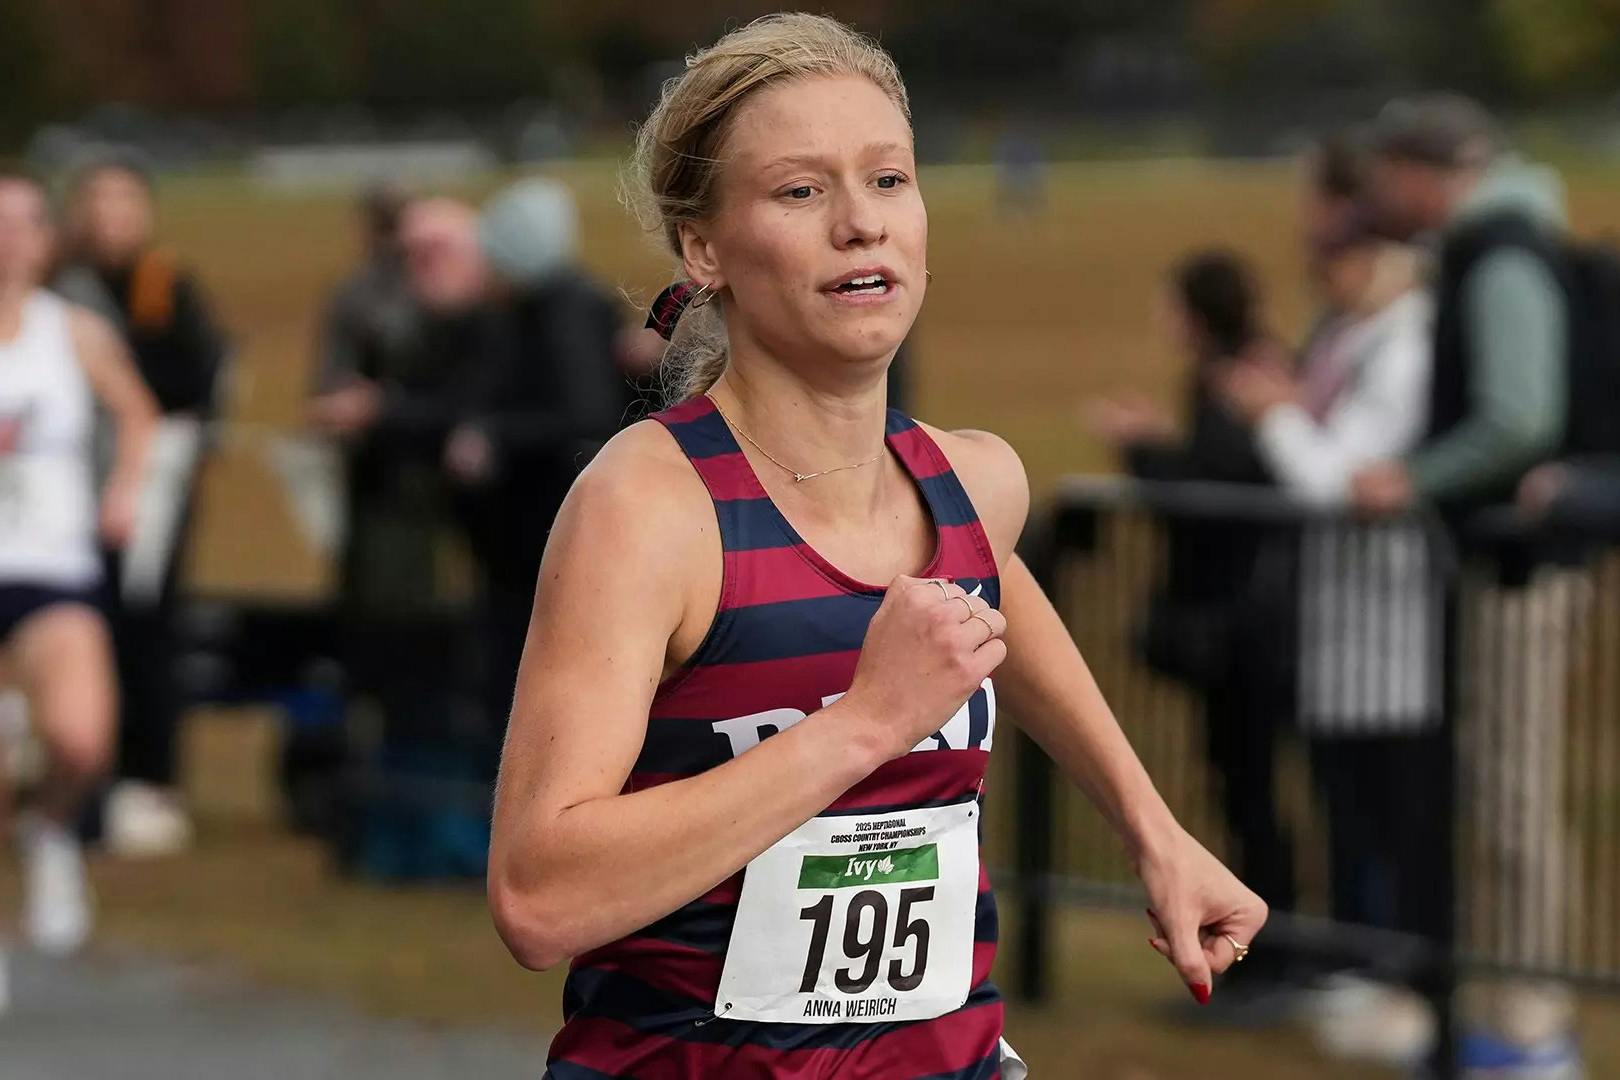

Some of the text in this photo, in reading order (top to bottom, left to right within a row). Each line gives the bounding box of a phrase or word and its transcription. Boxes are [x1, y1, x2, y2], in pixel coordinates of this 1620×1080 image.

[855, 818, 906, 832] 2025 HEPTAGONAL
[830, 826, 927, 844] CROSS COUNTRY CHAMPIONSHIPS
[858, 843, 873, 852] NEW
[888, 841, 898, 849] NY
[844, 857, 878, 881] Ivy
[798, 885, 935, 995] 195
[803, 997, 897, 1018] ANNA WEIRICH
